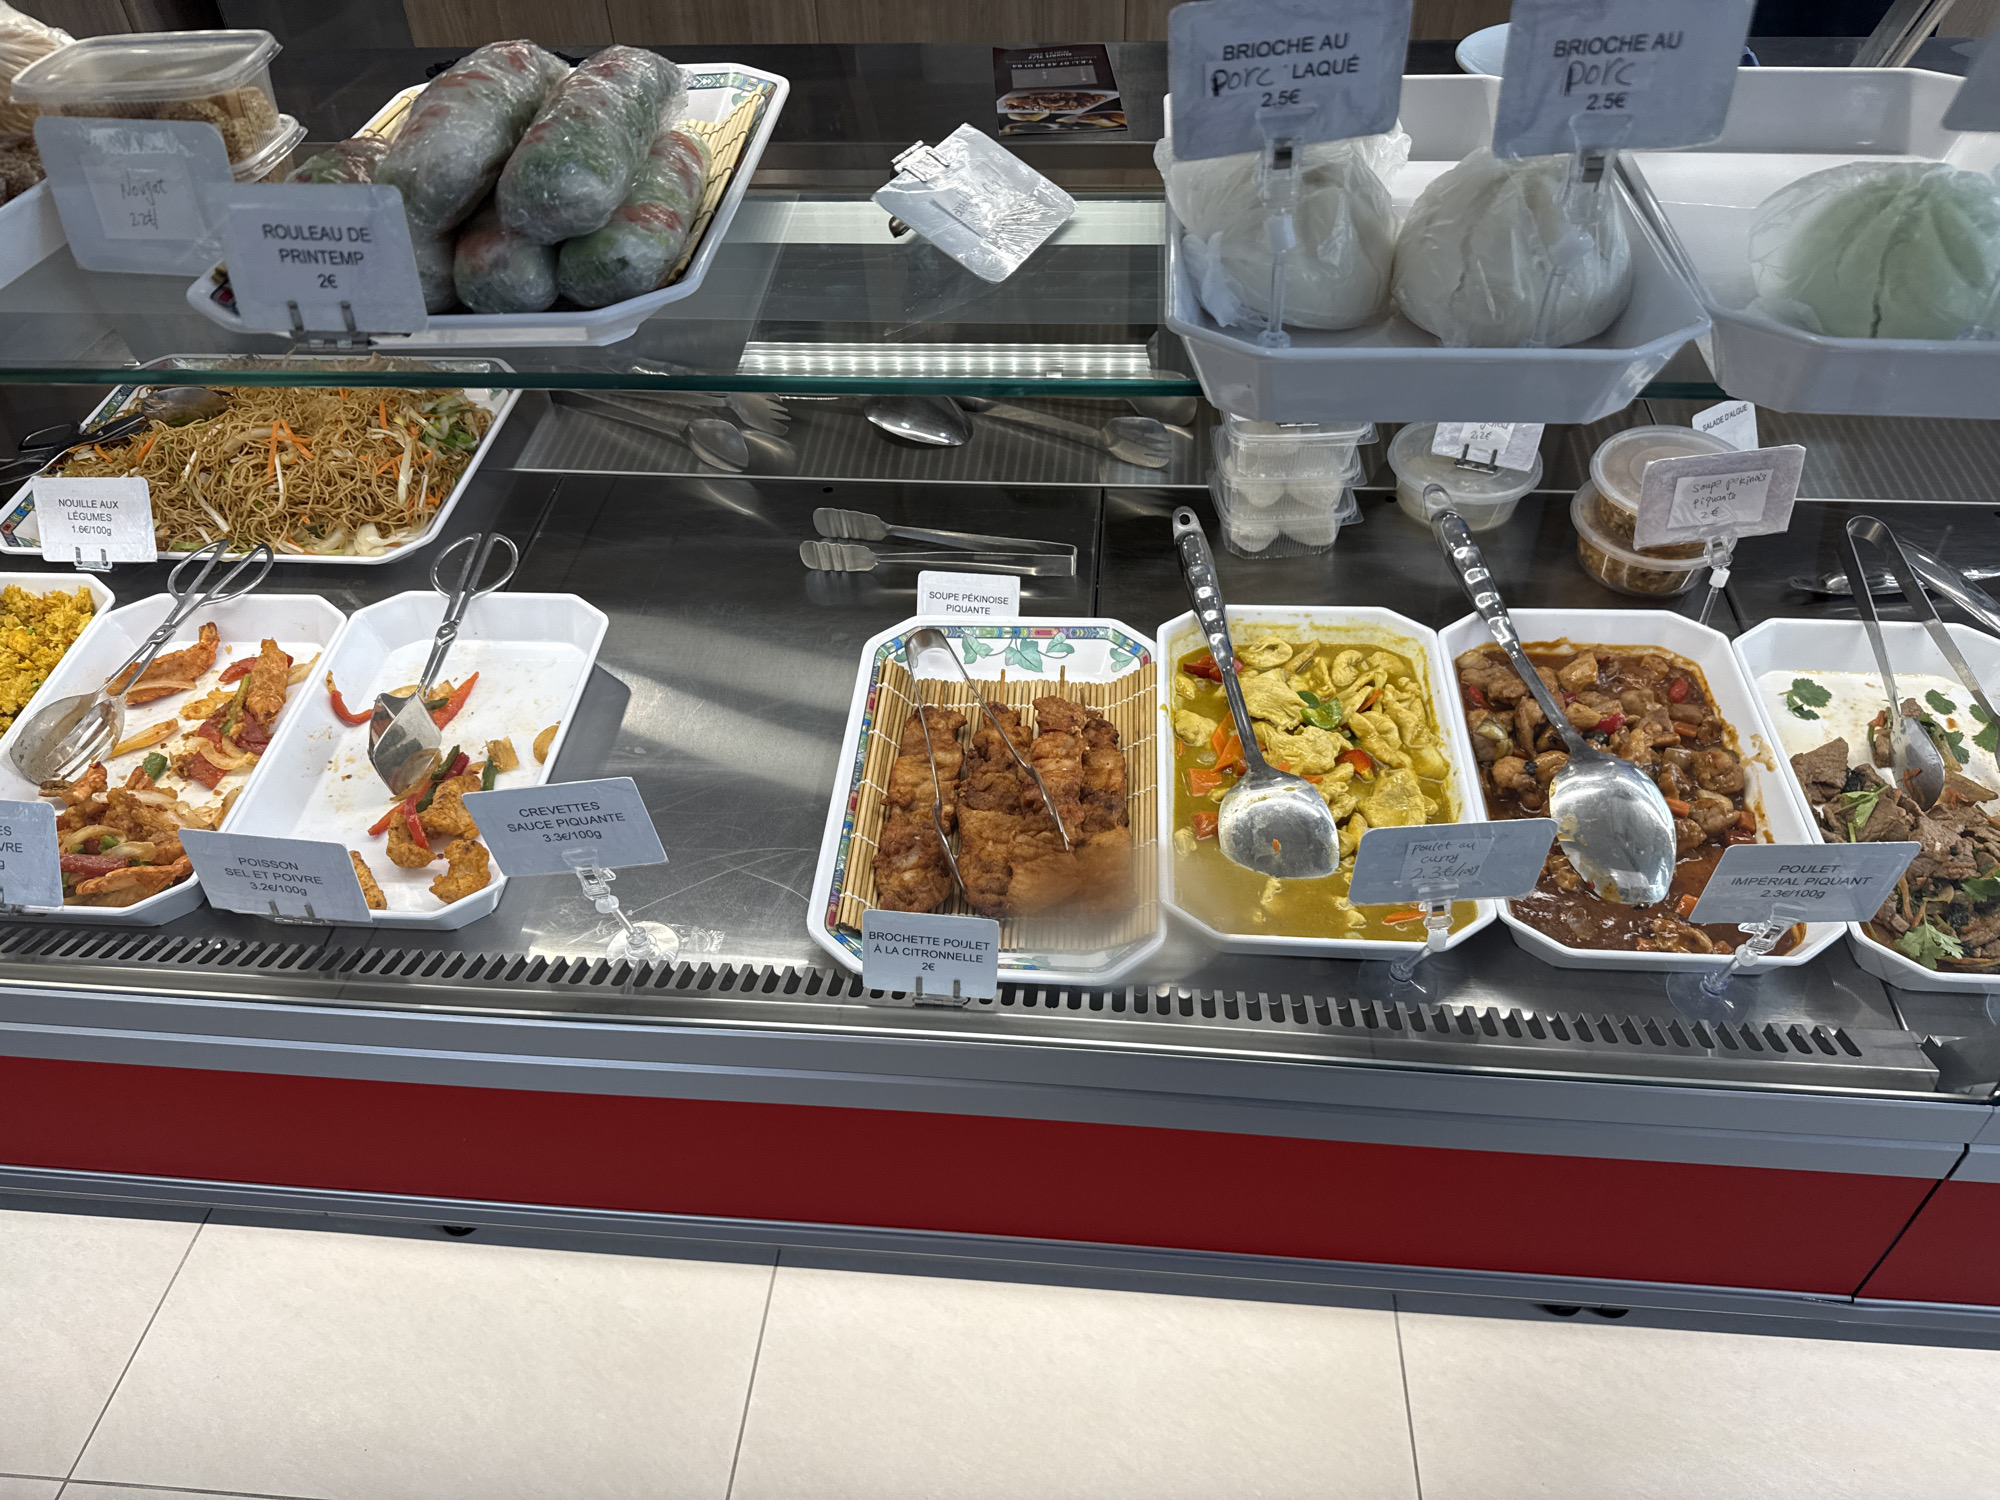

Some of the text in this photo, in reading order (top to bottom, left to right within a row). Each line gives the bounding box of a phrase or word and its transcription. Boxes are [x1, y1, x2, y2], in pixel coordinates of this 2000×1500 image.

[1222, 32, 1348, 61] BRIOCHE AU
[1553, 31, 1684, 57] BRIOCHE AU
[1292, 54, 1359, 80] LAQUÉ
[1261, 88, 1301, 107] 2.5€
[1586, 92, 1629, 111] 2.5€
[262, 224, 372, 243] ROULEAU DE
[279, 248, 364, 266] PRINTEMP
[317, 273, 338, 289] 2€
[1702, 403, 1748, 431] SALADE D'ALGUE
[58, 499, 119, 509] NOUILLE AUX
[67, 511, 112, 522] LÉGUMES
[71, 525, 111, 536] 1.6€/100g
[929, 591, 1009, 605] SOUPE PÉKINOISE
[946, 604, 991, 615] PIQUANTE
[519, 801, 600, 818] CREVETTES
[507, 812, 626, 833] SAUCE PIQUANTE
[542, 829, 602, 843] 3.3€/100g
[238, 857, 299, 871] POISSON
[1778, 864, 1841, 874] POULET
[224, 867, 323, 885] SEL ET POIVRE
[1731, 875, 1873, 886] IMPÉRIAL PIQUANT
[250, 881, 307, 896] 3.2€/100g
[1760, 889, 1826, 899] 2.3€/100g
[869, 931, 990, 951] BROCHETTE POULET
[874, 943, 983, 963] À LA CITRONNELLE
[921, 962, 935, 971] 2€
